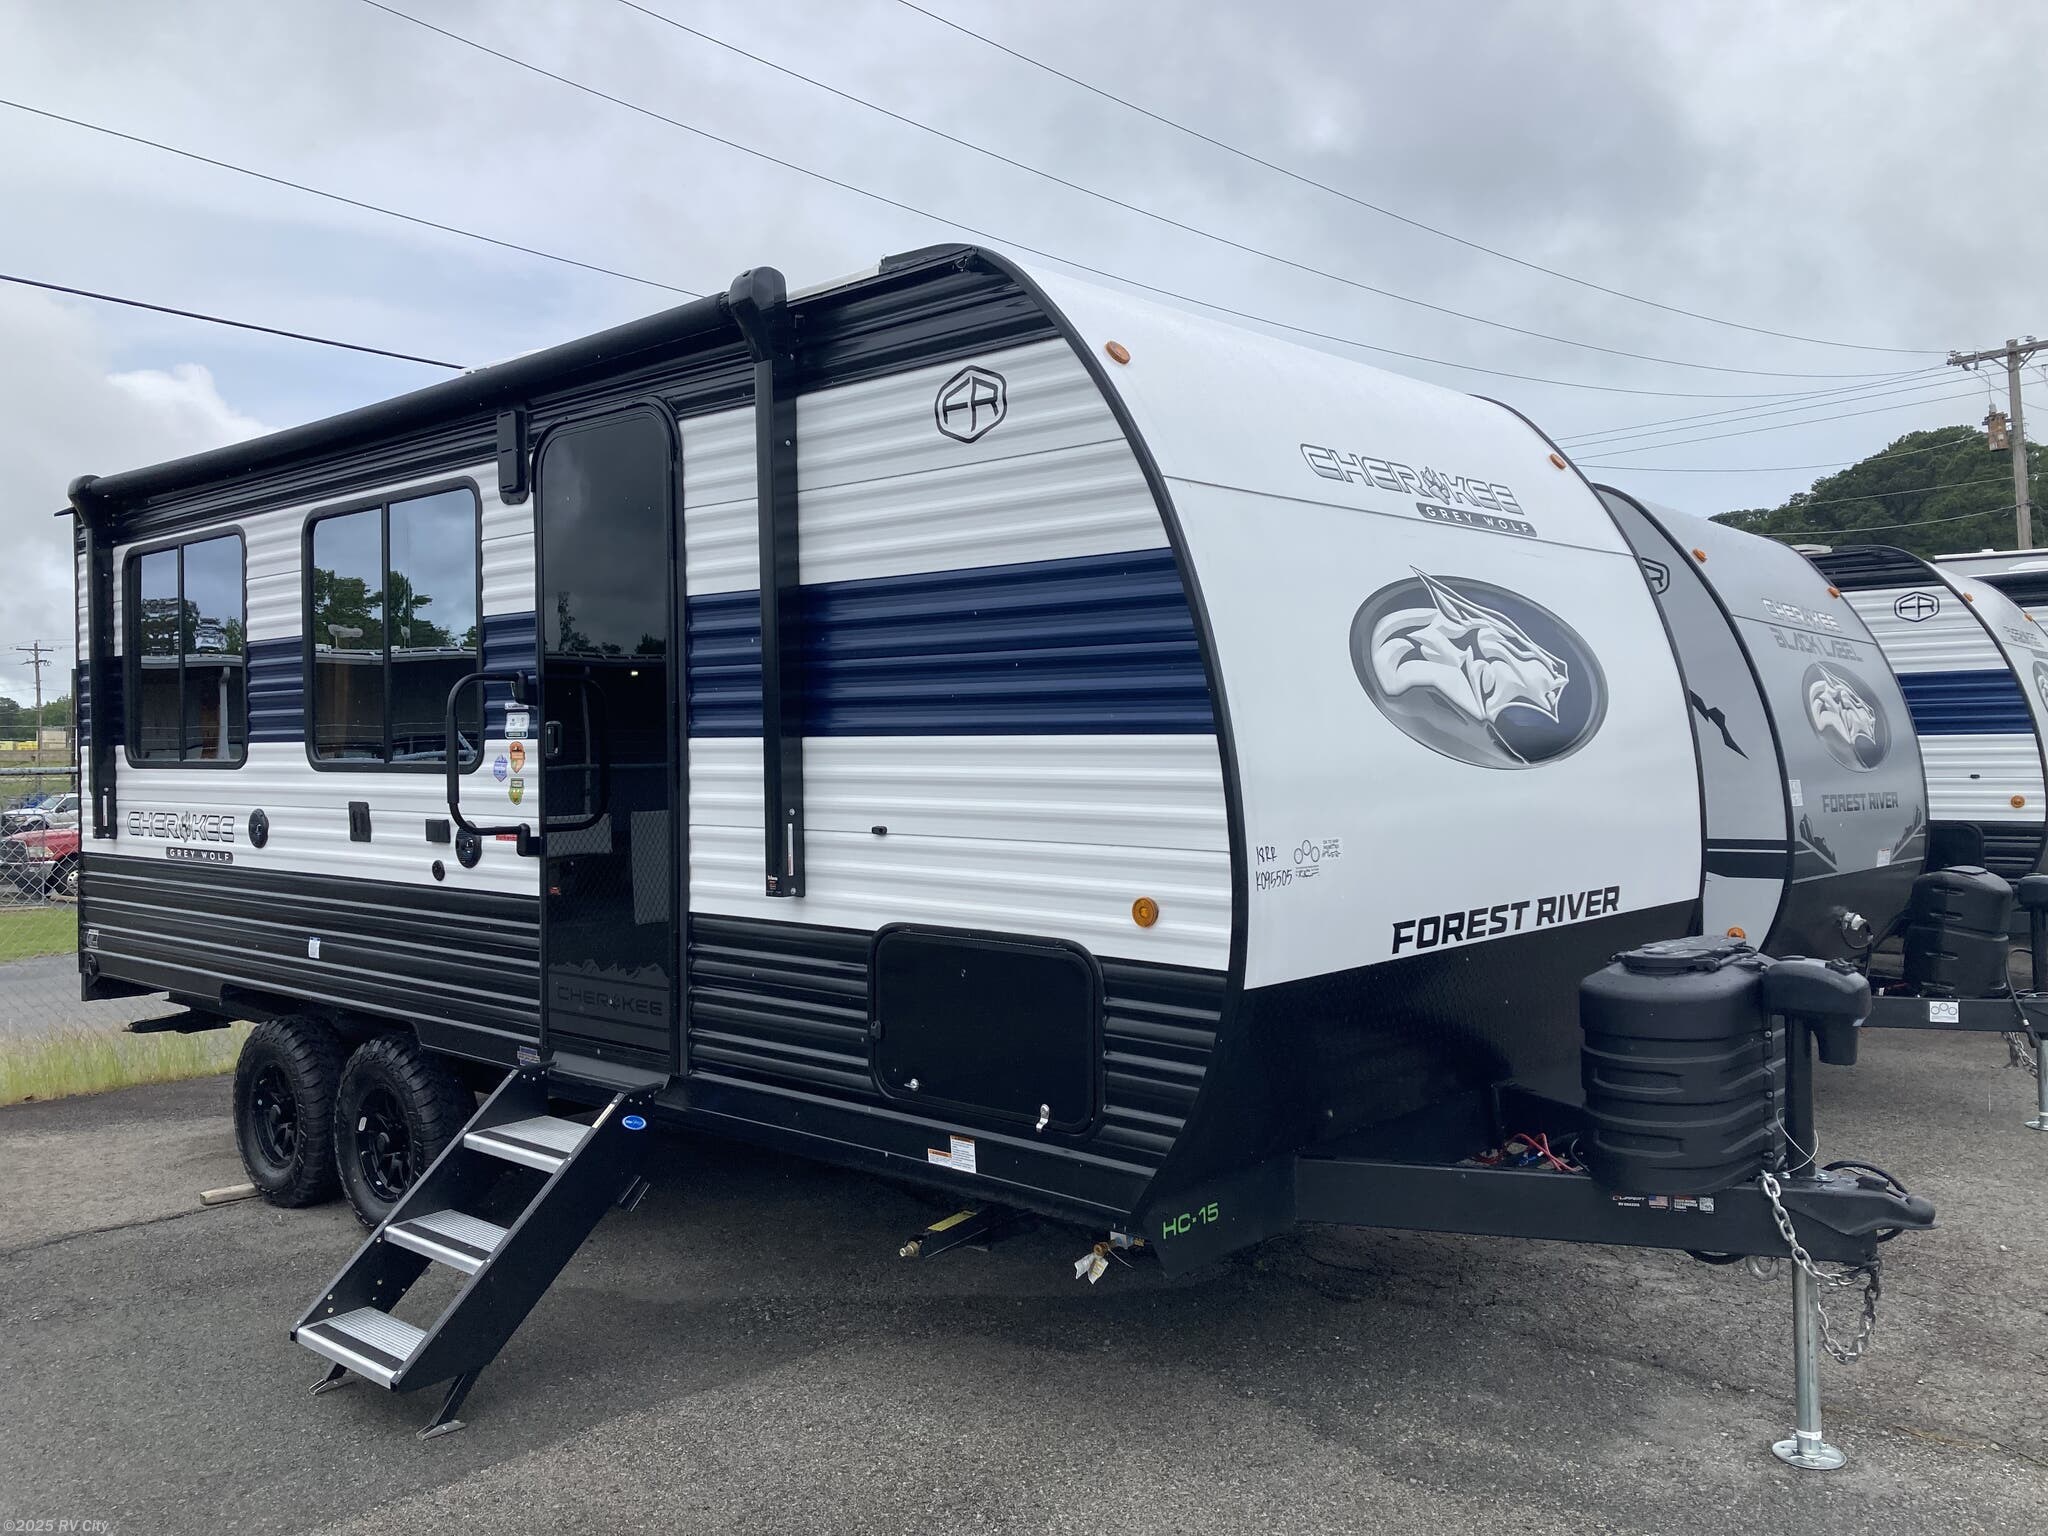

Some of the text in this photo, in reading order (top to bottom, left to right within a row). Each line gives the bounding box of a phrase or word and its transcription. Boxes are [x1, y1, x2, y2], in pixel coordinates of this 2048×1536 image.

[1300, 443, 1525, 516] CHEROKEE
[1425, 506, 1530, 534] GREY WOLF
[1821, 791, 1899, 813] FOREST RIVER
[127, 811, 235, 843] CHEROKEE
[169, 848, 230, 861] GREY WOLF
[1392, 886, 1620, 955] FOREST RIVER
[557, 985, 664, 1017] CHEROKEE
[1163, 1202, 1219, 1240] HC-15
